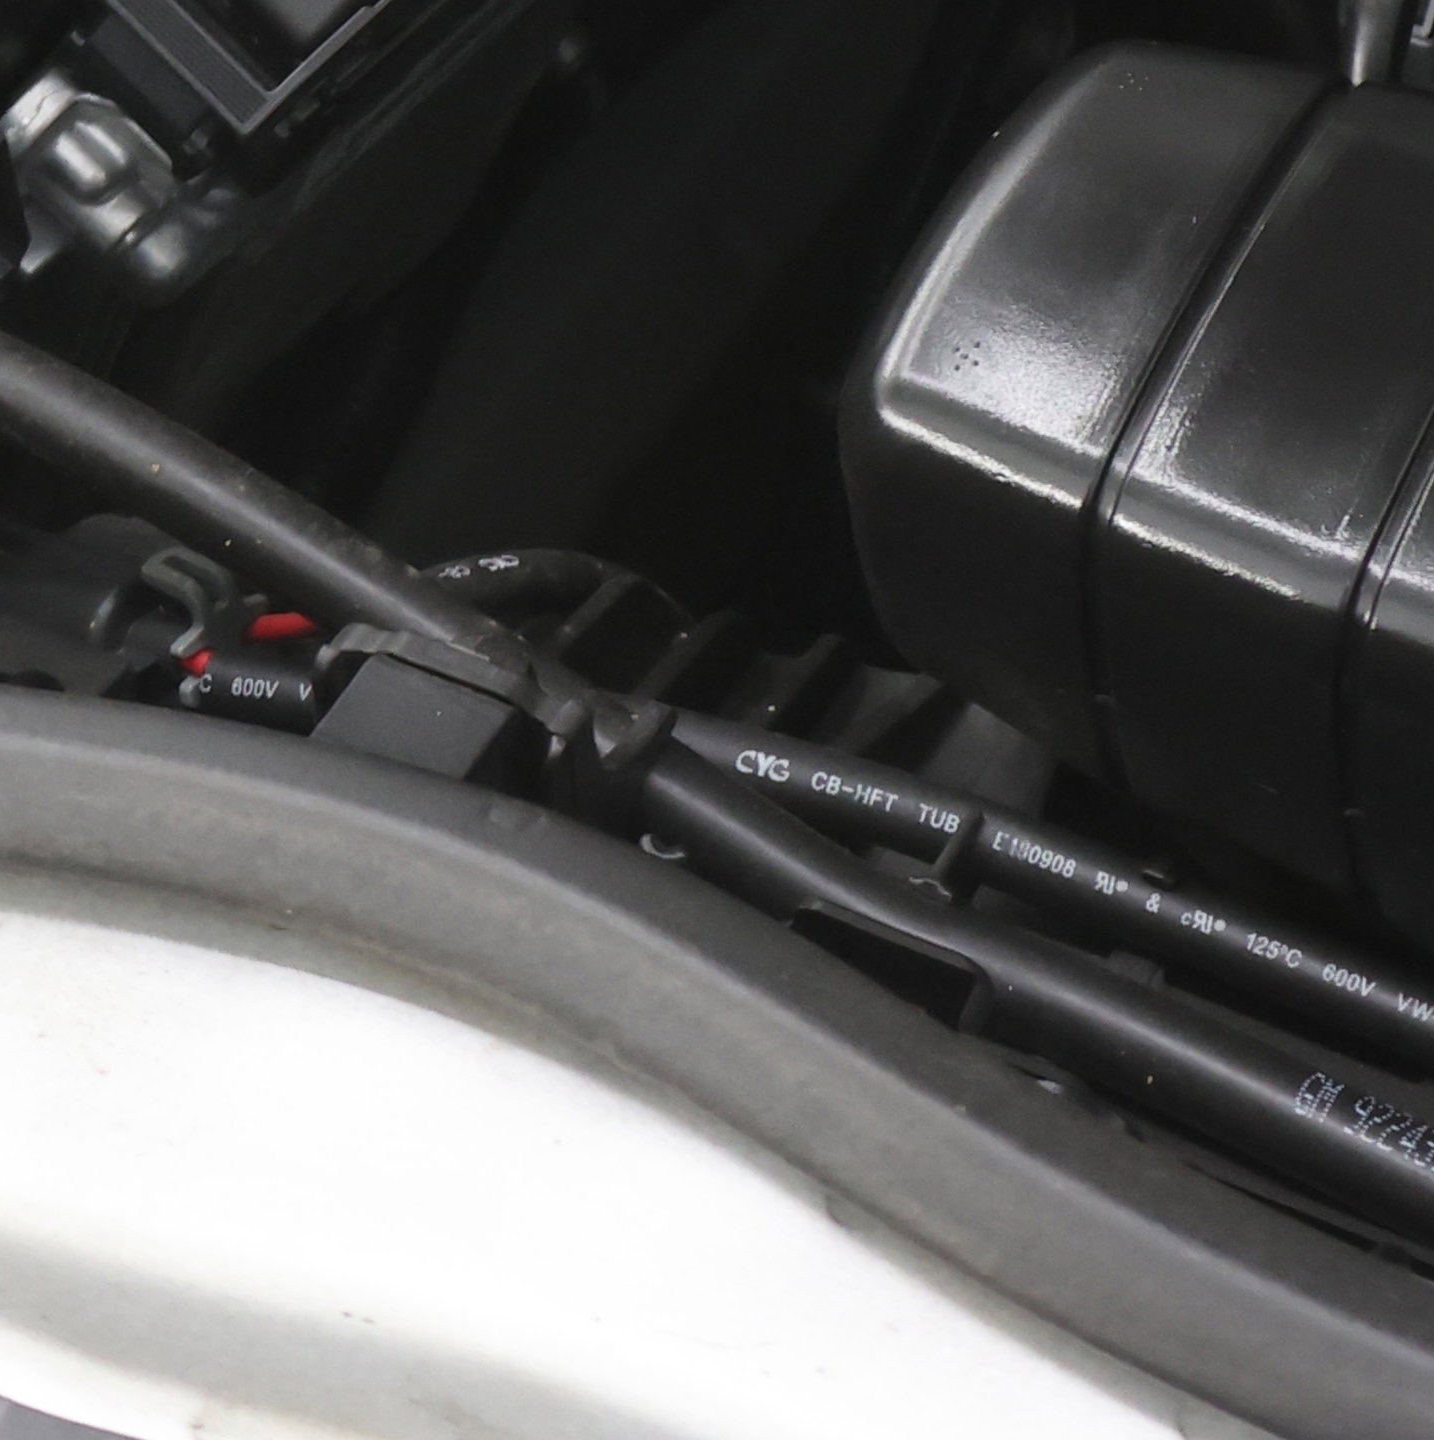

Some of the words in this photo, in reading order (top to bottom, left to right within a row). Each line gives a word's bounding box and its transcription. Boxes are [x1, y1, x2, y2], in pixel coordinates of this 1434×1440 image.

[231, 676, 280, 700] 600V
[734, 749, 791, 783] CYG
[811, 770, 900, 813] CB-HFT
[918, 802, 962, 834] TUB
[1145, 892, 1163, 915] &
[1322, 963, 1377, 998] 600V
